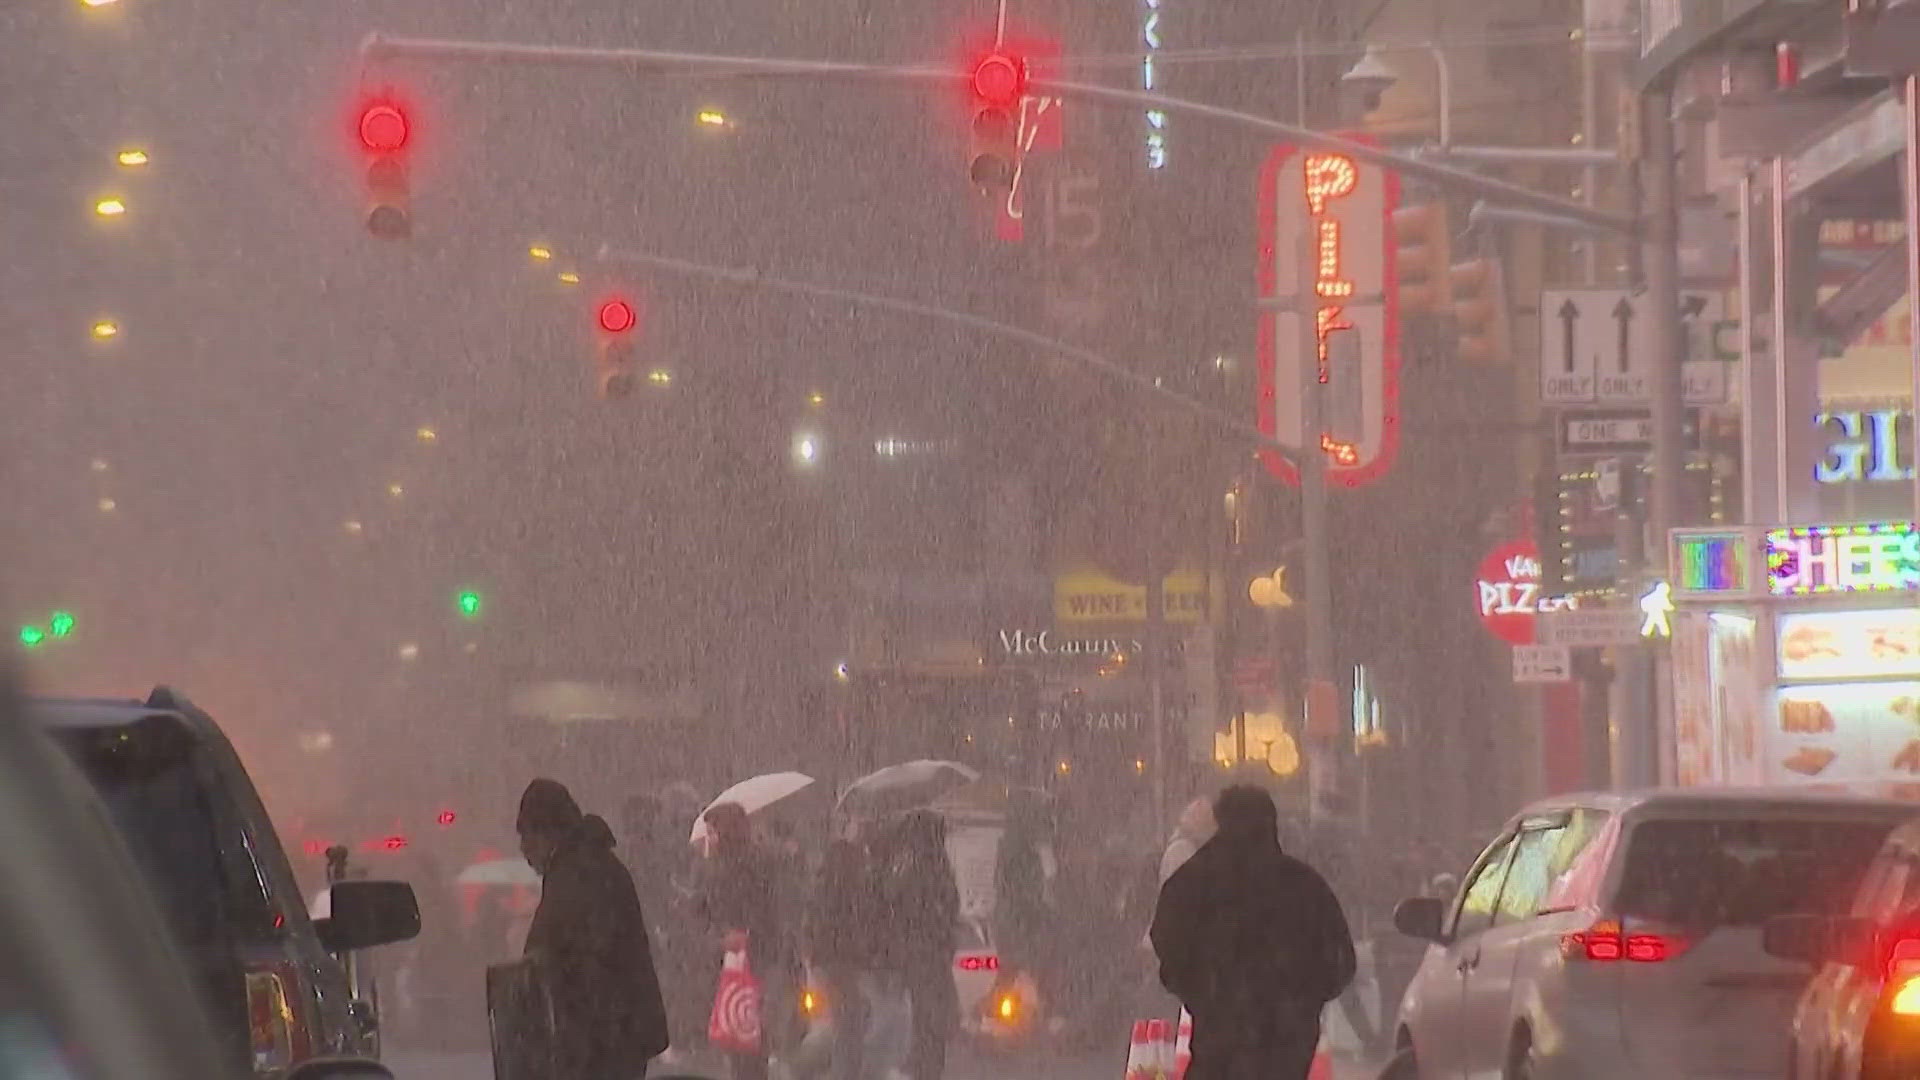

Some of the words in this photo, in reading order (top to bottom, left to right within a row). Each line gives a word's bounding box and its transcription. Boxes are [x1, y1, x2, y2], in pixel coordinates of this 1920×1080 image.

[1546, 377, 1591, 396] ONLY
[1602, 377, 1644, 396] ONLY
[1578, 423, 1618, 440] ONE
[1070, 594, 1126, 616] WINE
